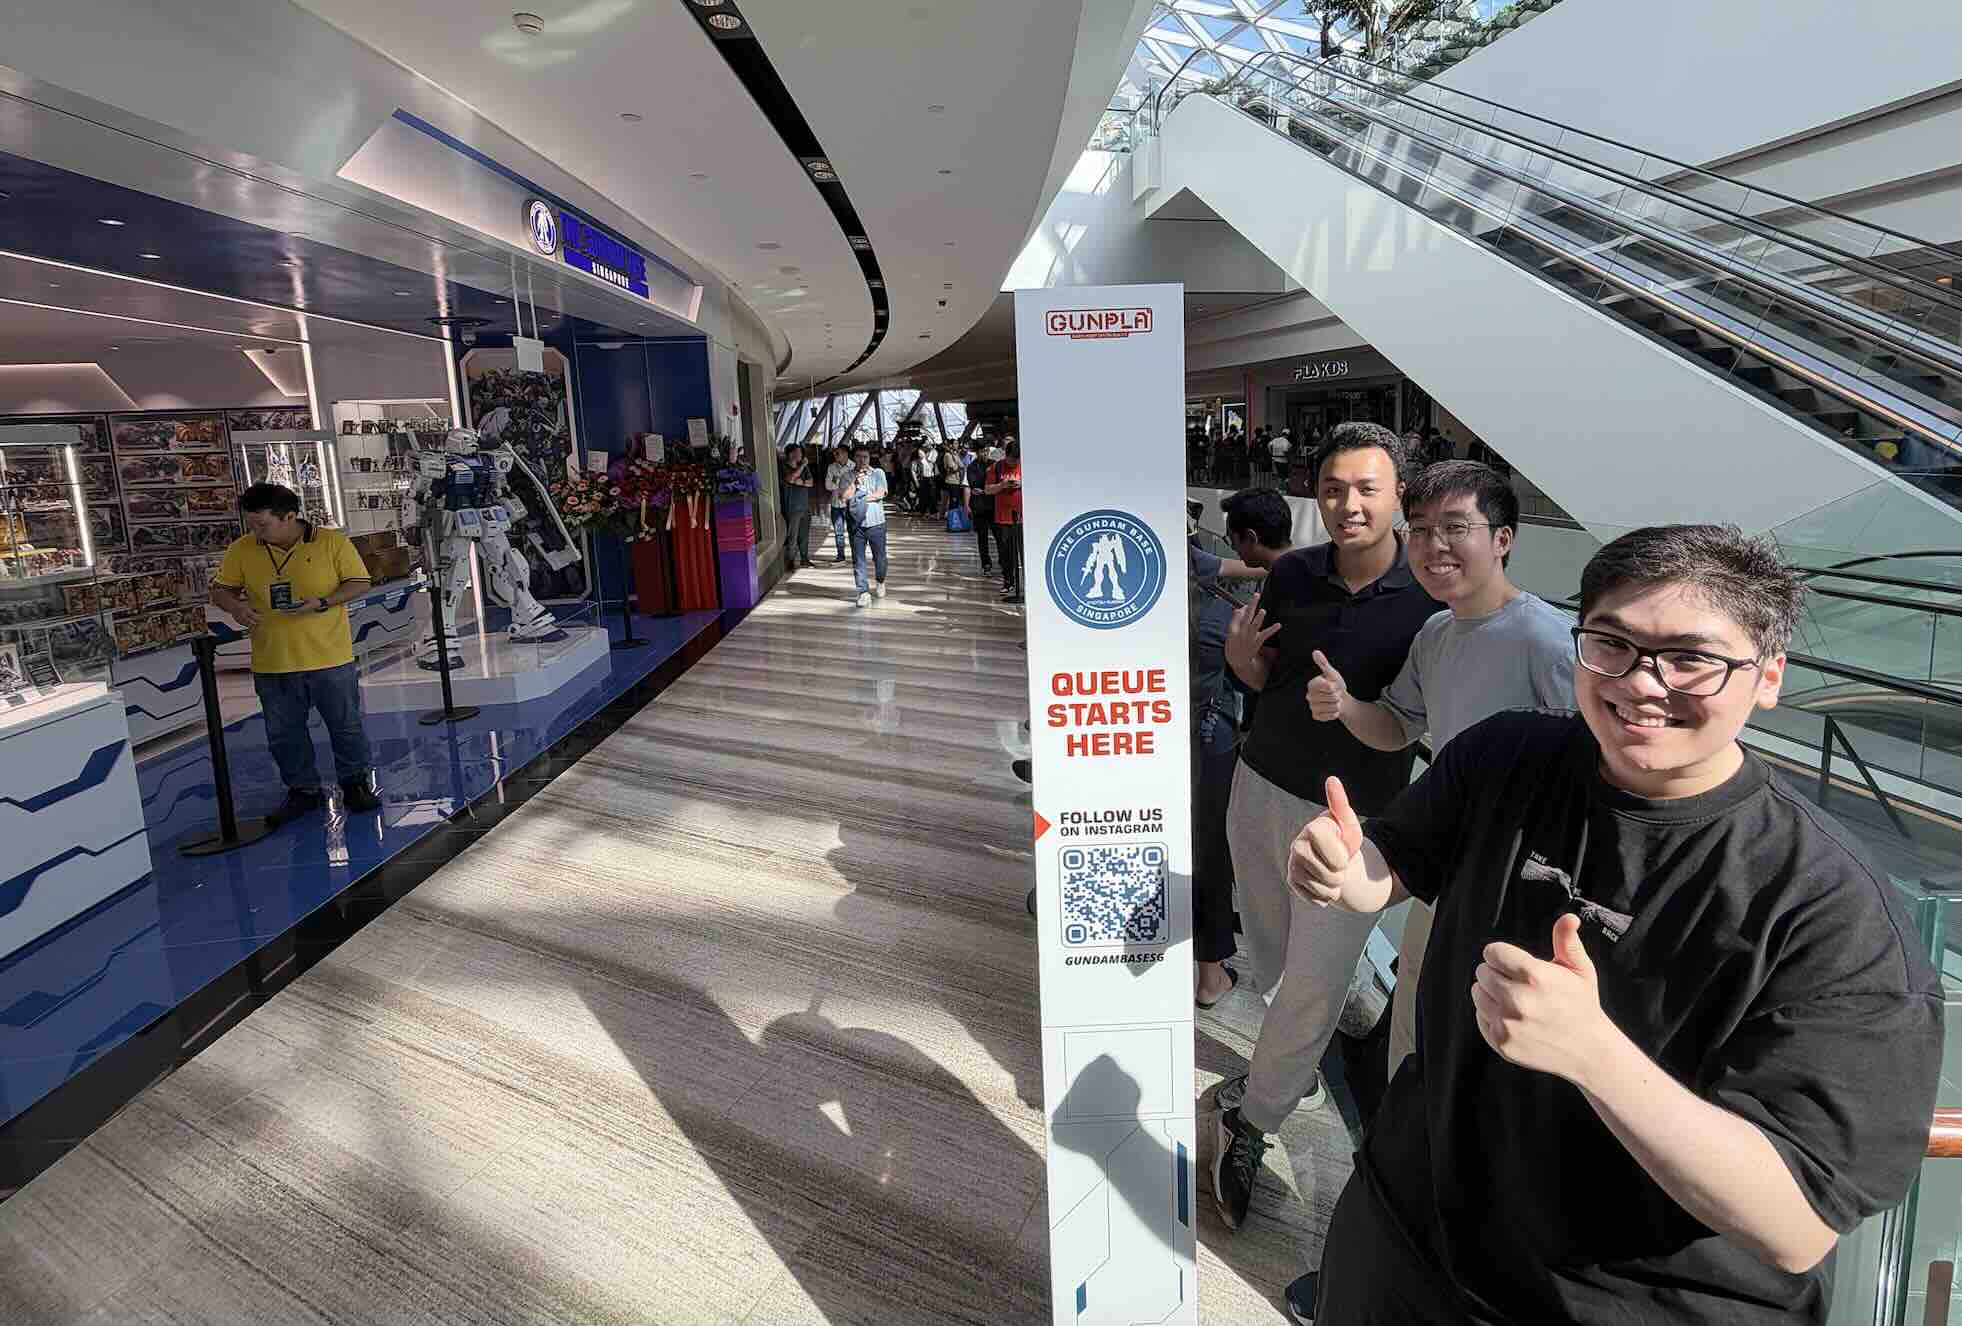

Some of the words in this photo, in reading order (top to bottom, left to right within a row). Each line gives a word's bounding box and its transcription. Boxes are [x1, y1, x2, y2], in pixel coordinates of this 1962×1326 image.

[1050, 312, 1149, 331] GUNPLA
[1057, 537, 1074, 559] THE
[1075, 519, 1127, 537] GUNDAM
[1129, 528, 1154, 556] BASE
[1076, 602, 1138, 621] SINGAPORE
[1051, 669, 1166, 697] QUEUE
[1047, 700, 1172, 727] STARTS
[1066, 731, 1154, 757] HERE
[1060, 809, 1133, 825] FOLLOW
[1139, 808, 1163, 821] US
[1060, 826, 1080, 837] ON
[1085, 823, 1163, 836] INSTAGRAM
[1065, 952, 1164, 966] GUNDAMBASESG
